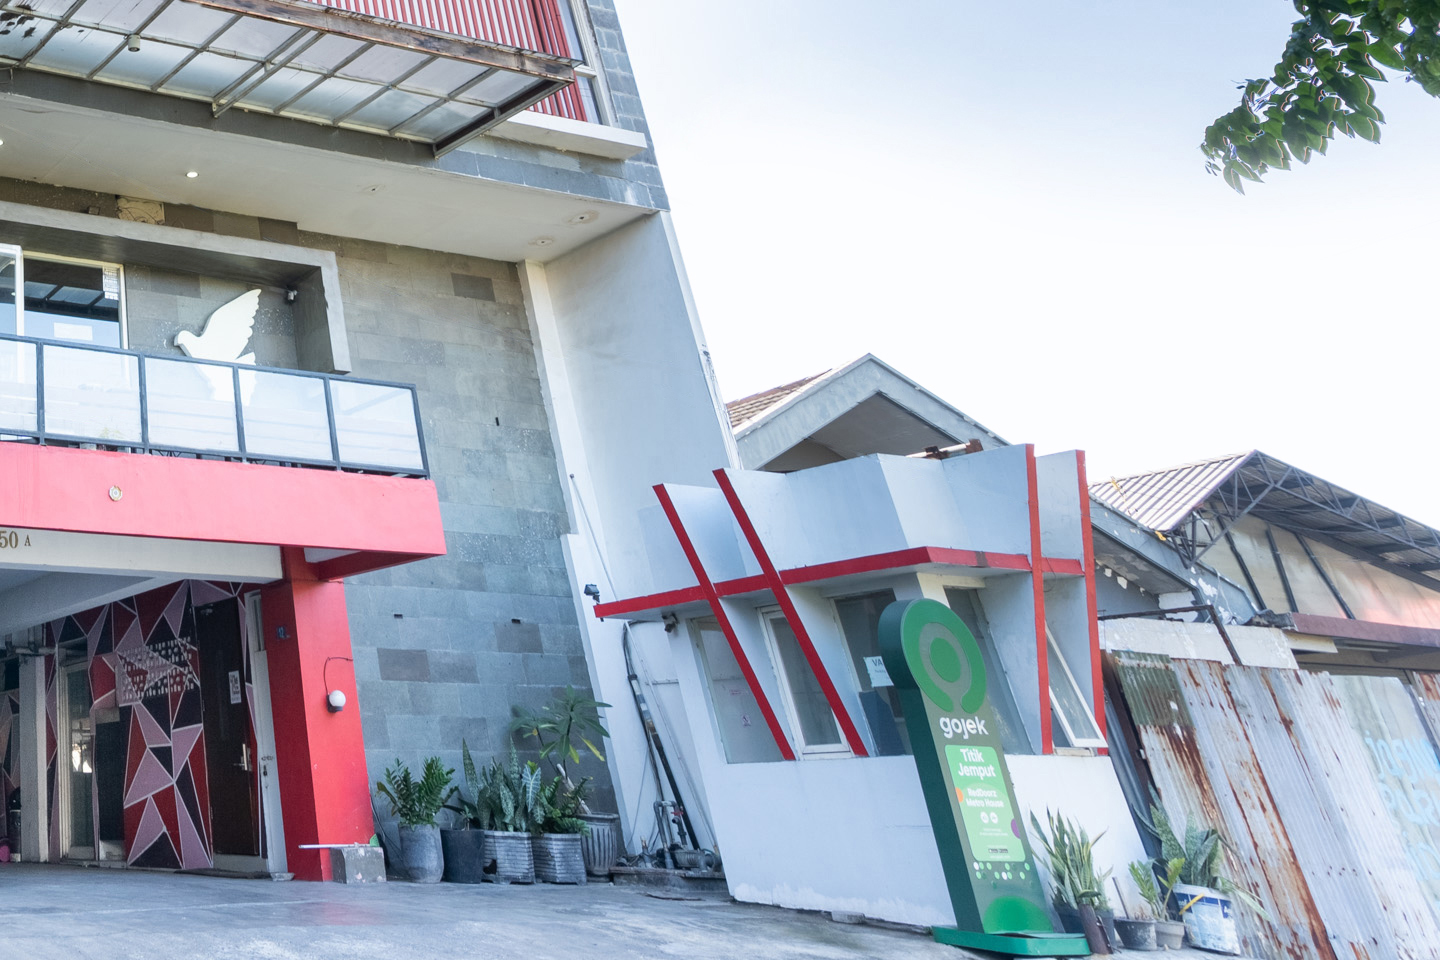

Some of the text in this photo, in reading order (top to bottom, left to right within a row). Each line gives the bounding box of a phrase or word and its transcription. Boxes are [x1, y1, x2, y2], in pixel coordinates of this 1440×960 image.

[24, 534, 31, 546] A
[940, 716, 989, 739] gojek
[960, 748, 984, 762] Titik
[958, 763, 996, 780] Jemput
